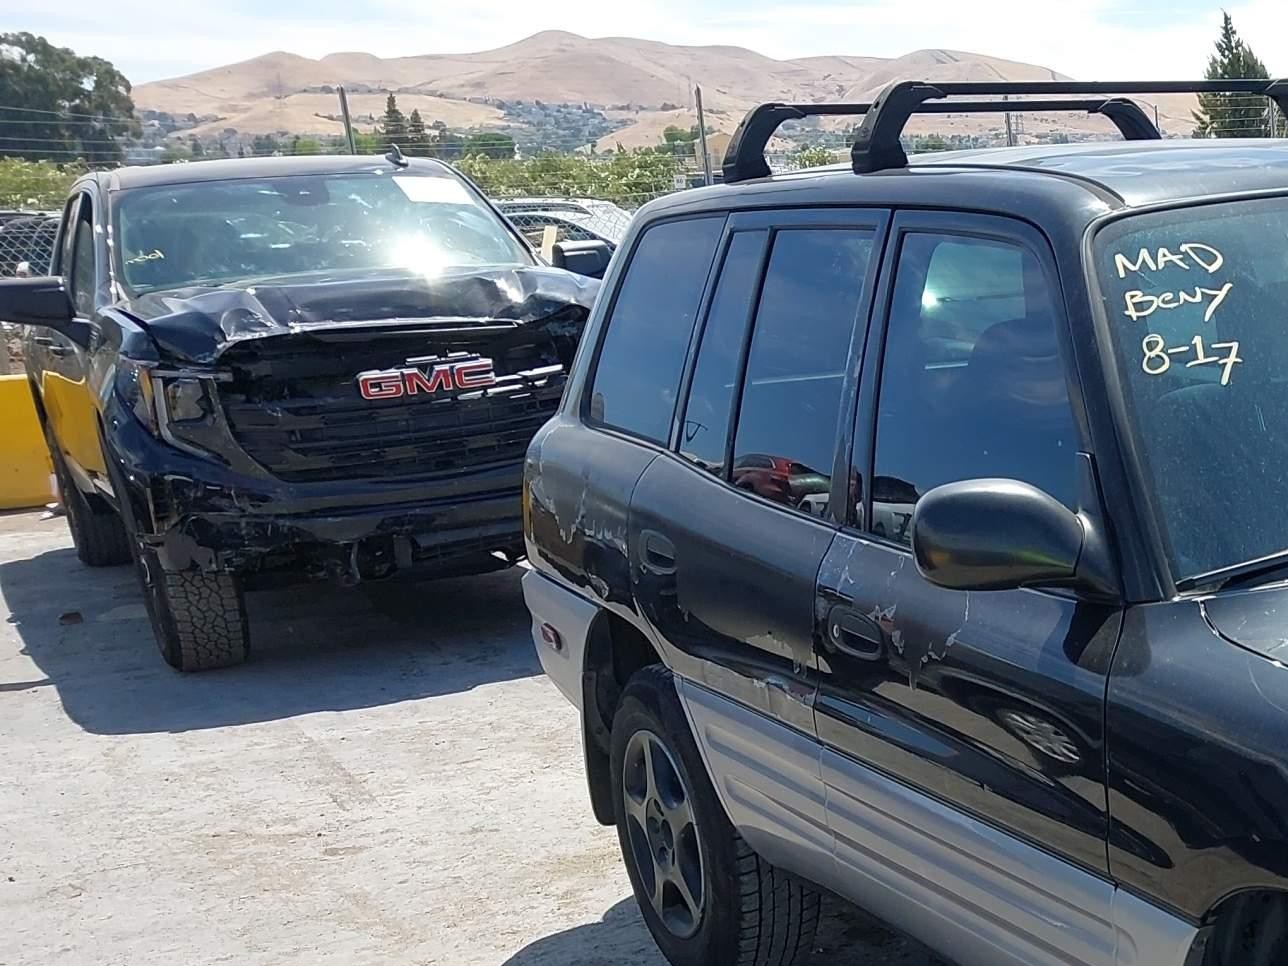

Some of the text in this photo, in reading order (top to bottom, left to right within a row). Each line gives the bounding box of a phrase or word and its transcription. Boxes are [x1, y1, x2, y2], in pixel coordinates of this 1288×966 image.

[1114, 243, 1224, 279] MAD
[358, 358, 497, 400] GMC
[1142, 333, 1243, 386] 8-17
